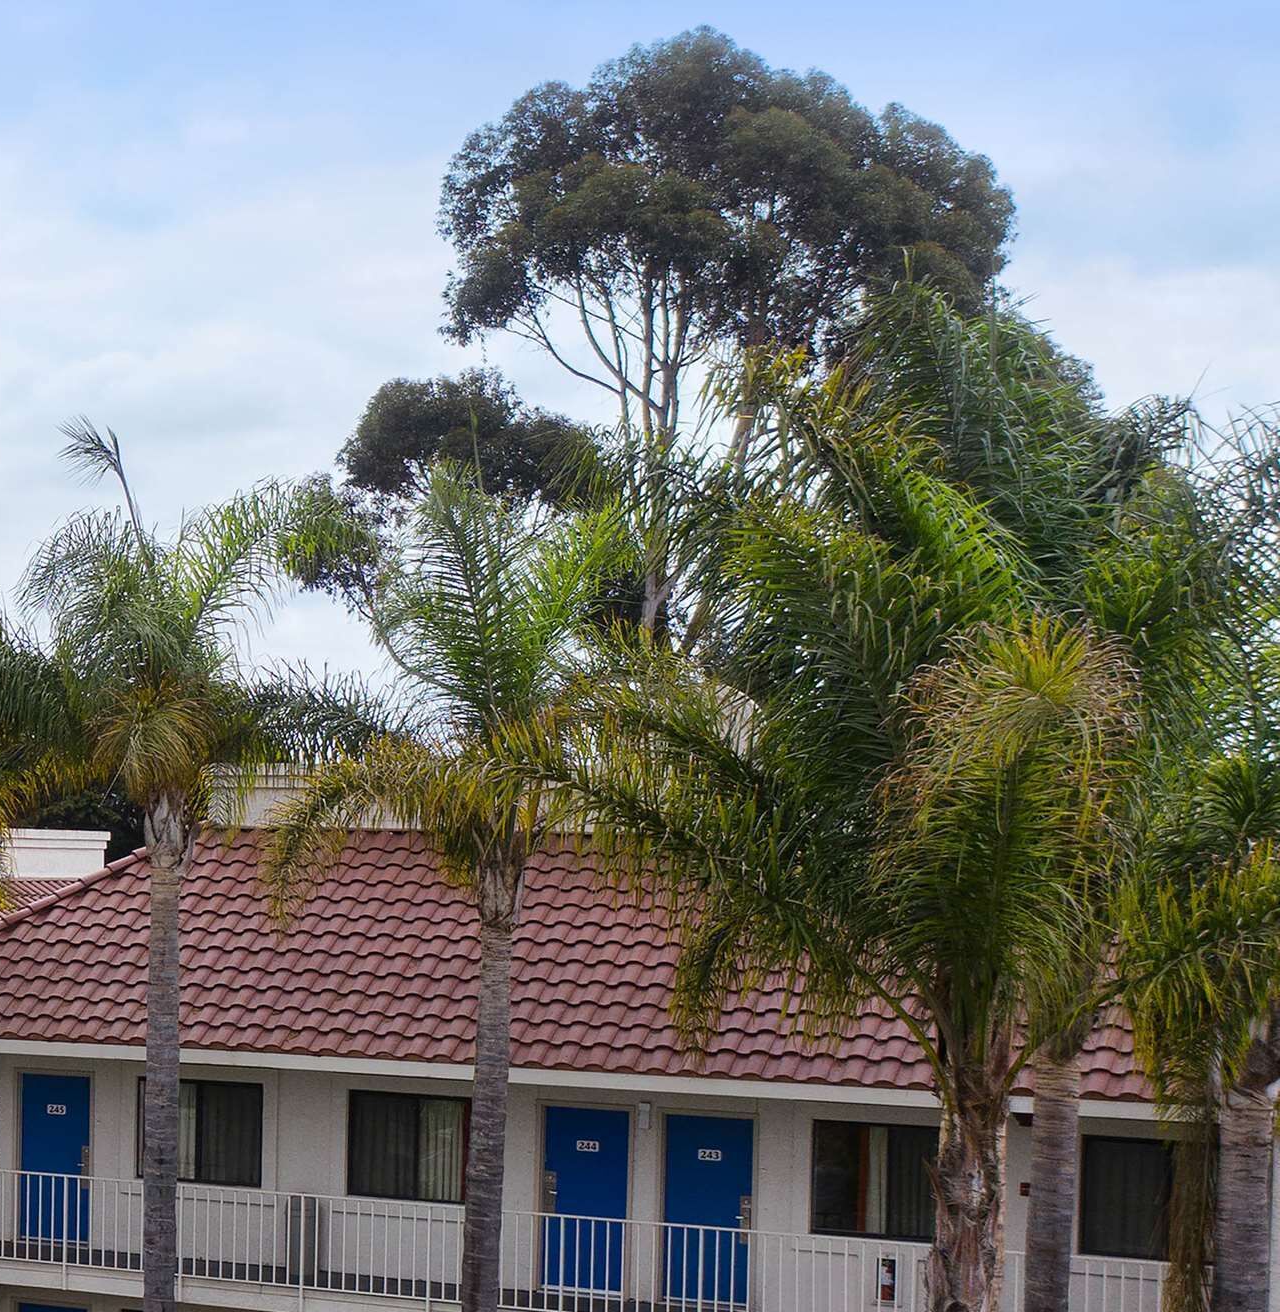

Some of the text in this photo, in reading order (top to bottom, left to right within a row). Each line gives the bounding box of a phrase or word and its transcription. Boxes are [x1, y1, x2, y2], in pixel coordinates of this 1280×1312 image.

[49, 1104, 65, 1114] 245
[577, 1141, 597, 1151] 244
[699, 1150, 720, 1160] 243
